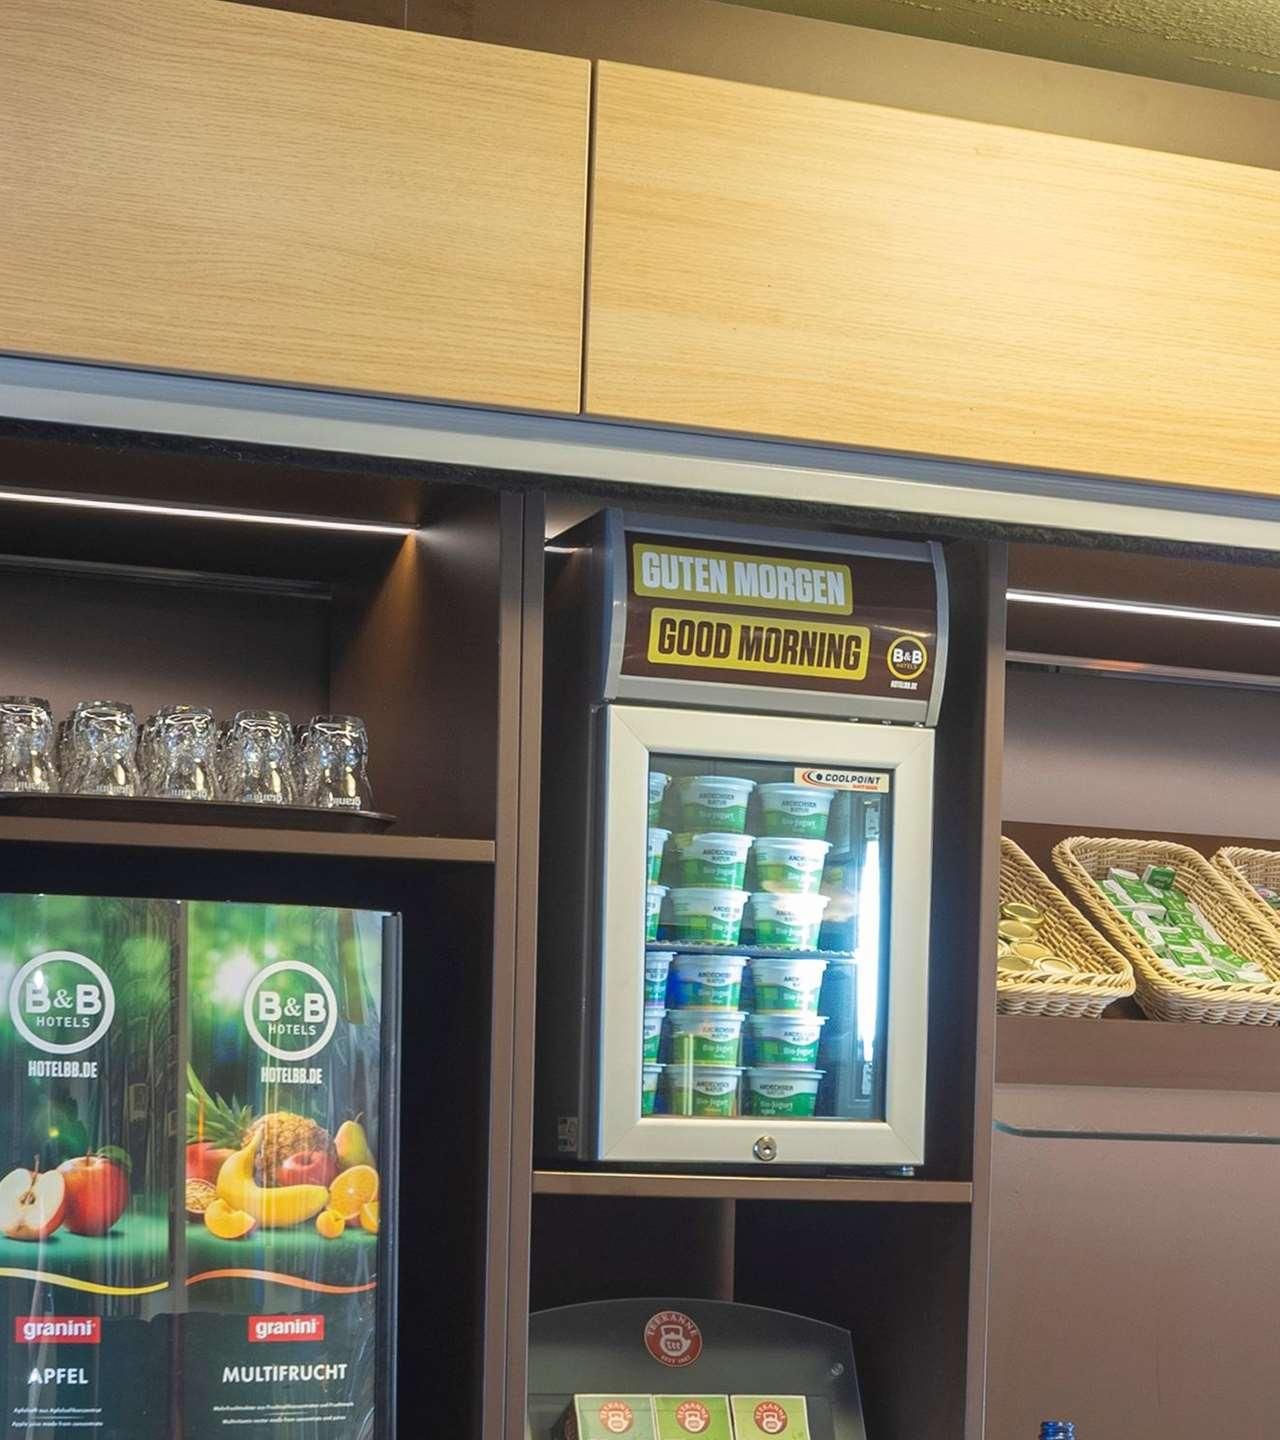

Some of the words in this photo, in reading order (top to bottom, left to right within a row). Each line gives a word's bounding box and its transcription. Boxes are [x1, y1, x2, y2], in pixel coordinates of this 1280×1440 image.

[641, 551, 728, 595] GUTEN
[734, 560, 846, 606] MORGEN
[657, 617, 733, 660] GOOD
[737, 624, 862, 671] MORNING
[893, 648, 923, 665] B&B
[825, 774, 881, 785] COOLPOINT
[25, 983, 102, 1015] B&B
[258, 990, 327, 1023] B&B
[36, 1015, 91, 1029] HOTELS
[268, 1022, 317, 1036] HOTELS
[27, 1060, 98, 1079] HOTELBB.DE
[260, 1066, 323, 1085] HOTELBB.DE
[22, 1320, 93, 1341] granini
[255, 1318, 317, 1339] granini
[27, 1368, 89, 1386] APFEL
[222, 1363, 348, 1384] MULTIFRUCHT
